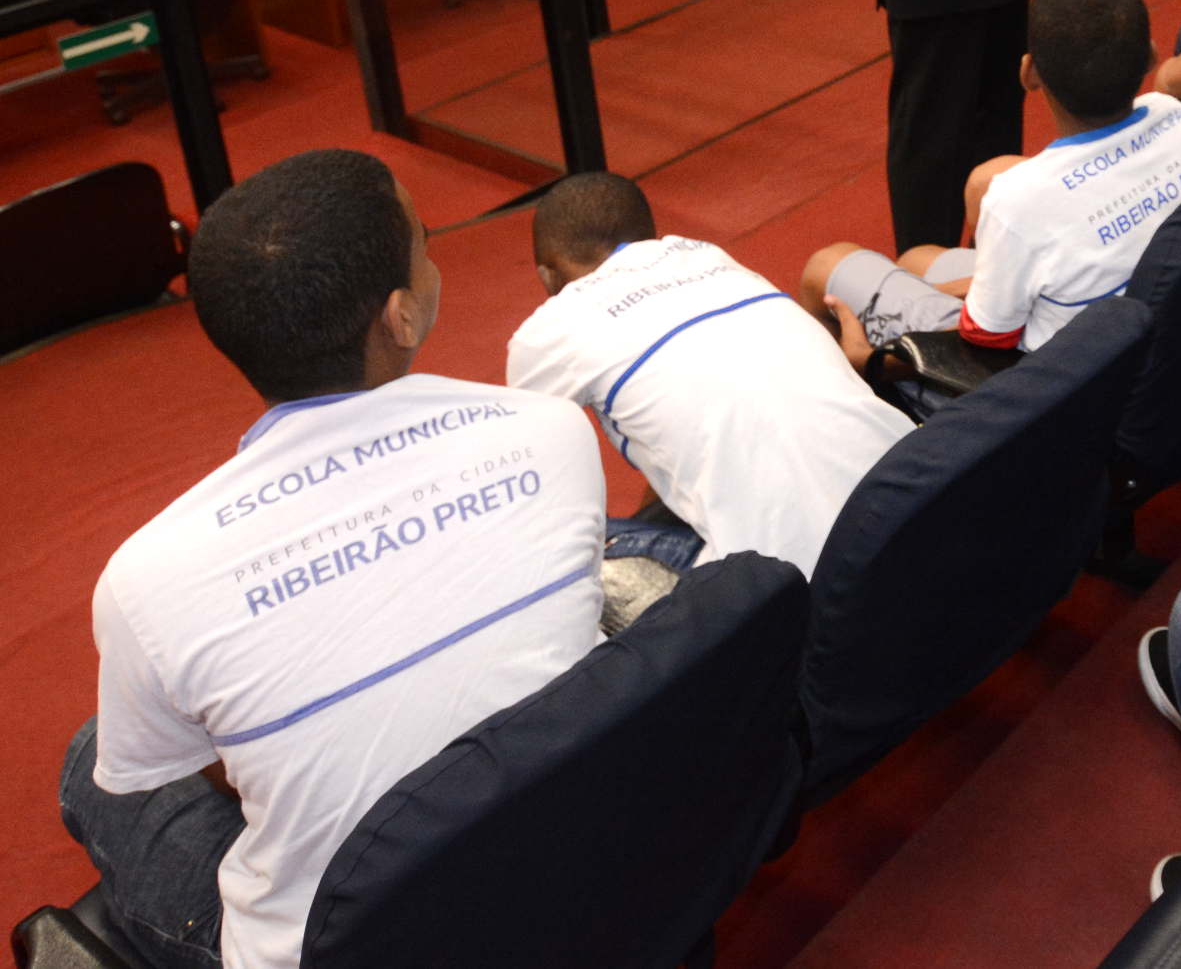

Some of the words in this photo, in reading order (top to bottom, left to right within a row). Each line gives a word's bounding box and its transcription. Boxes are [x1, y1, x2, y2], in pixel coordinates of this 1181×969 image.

[1061, 147, 1128, 191] ESCOLA
[1097, 182, 1180, 246] RIBEIRÃO
[215, 455, 348, 529] ESCOLA
[352, 402, 518, 467] MUNICIPAL
[234, 503, 393, 583] PREFEITURA
[411, 482, 442, 503] DA
[459, 445, 535, 483] CIDADE
[245, 516, 428, 617] RIBEIRÃO
[432, 469, 543, 532] PRETO
